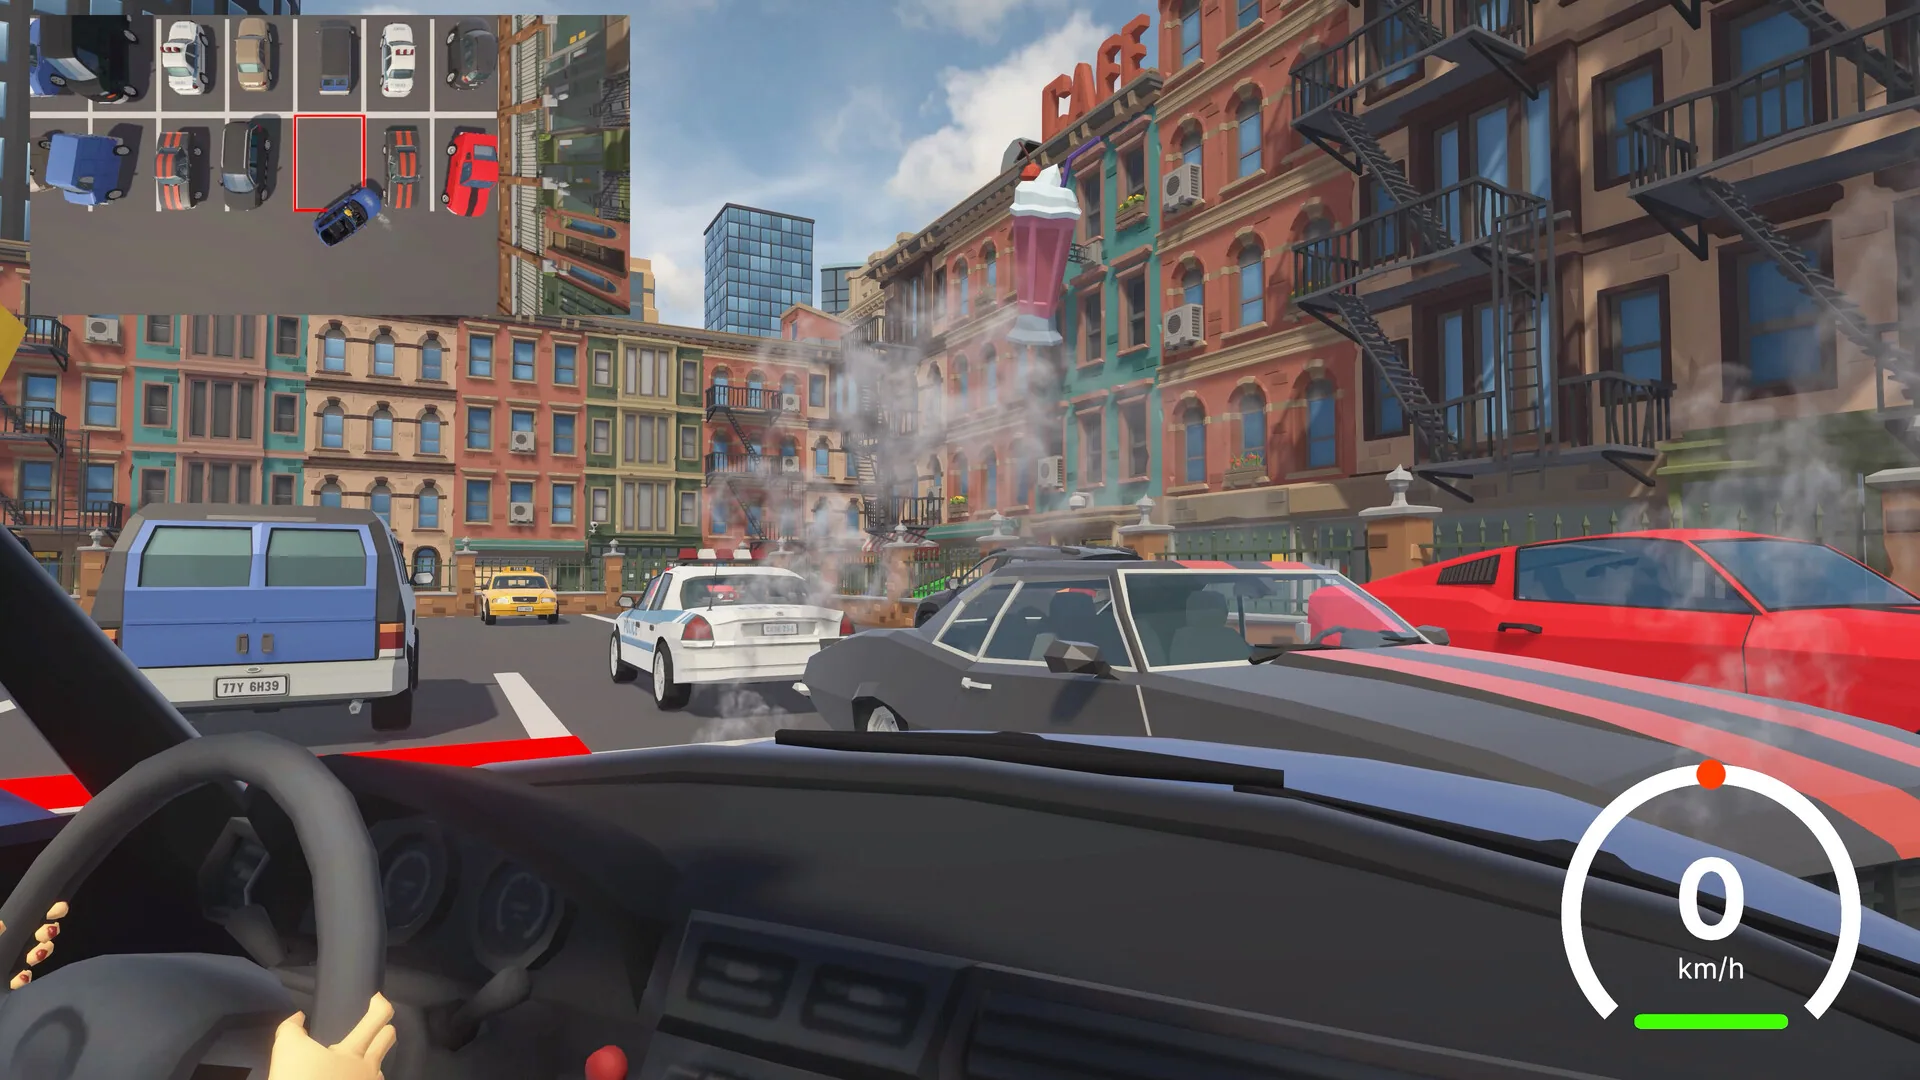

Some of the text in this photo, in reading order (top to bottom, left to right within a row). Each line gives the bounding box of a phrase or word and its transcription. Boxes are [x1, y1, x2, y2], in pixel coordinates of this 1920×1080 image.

[1042, 14, 1150, 144] CAFE
[222, 680, 280, 694] 77Y 6H39
